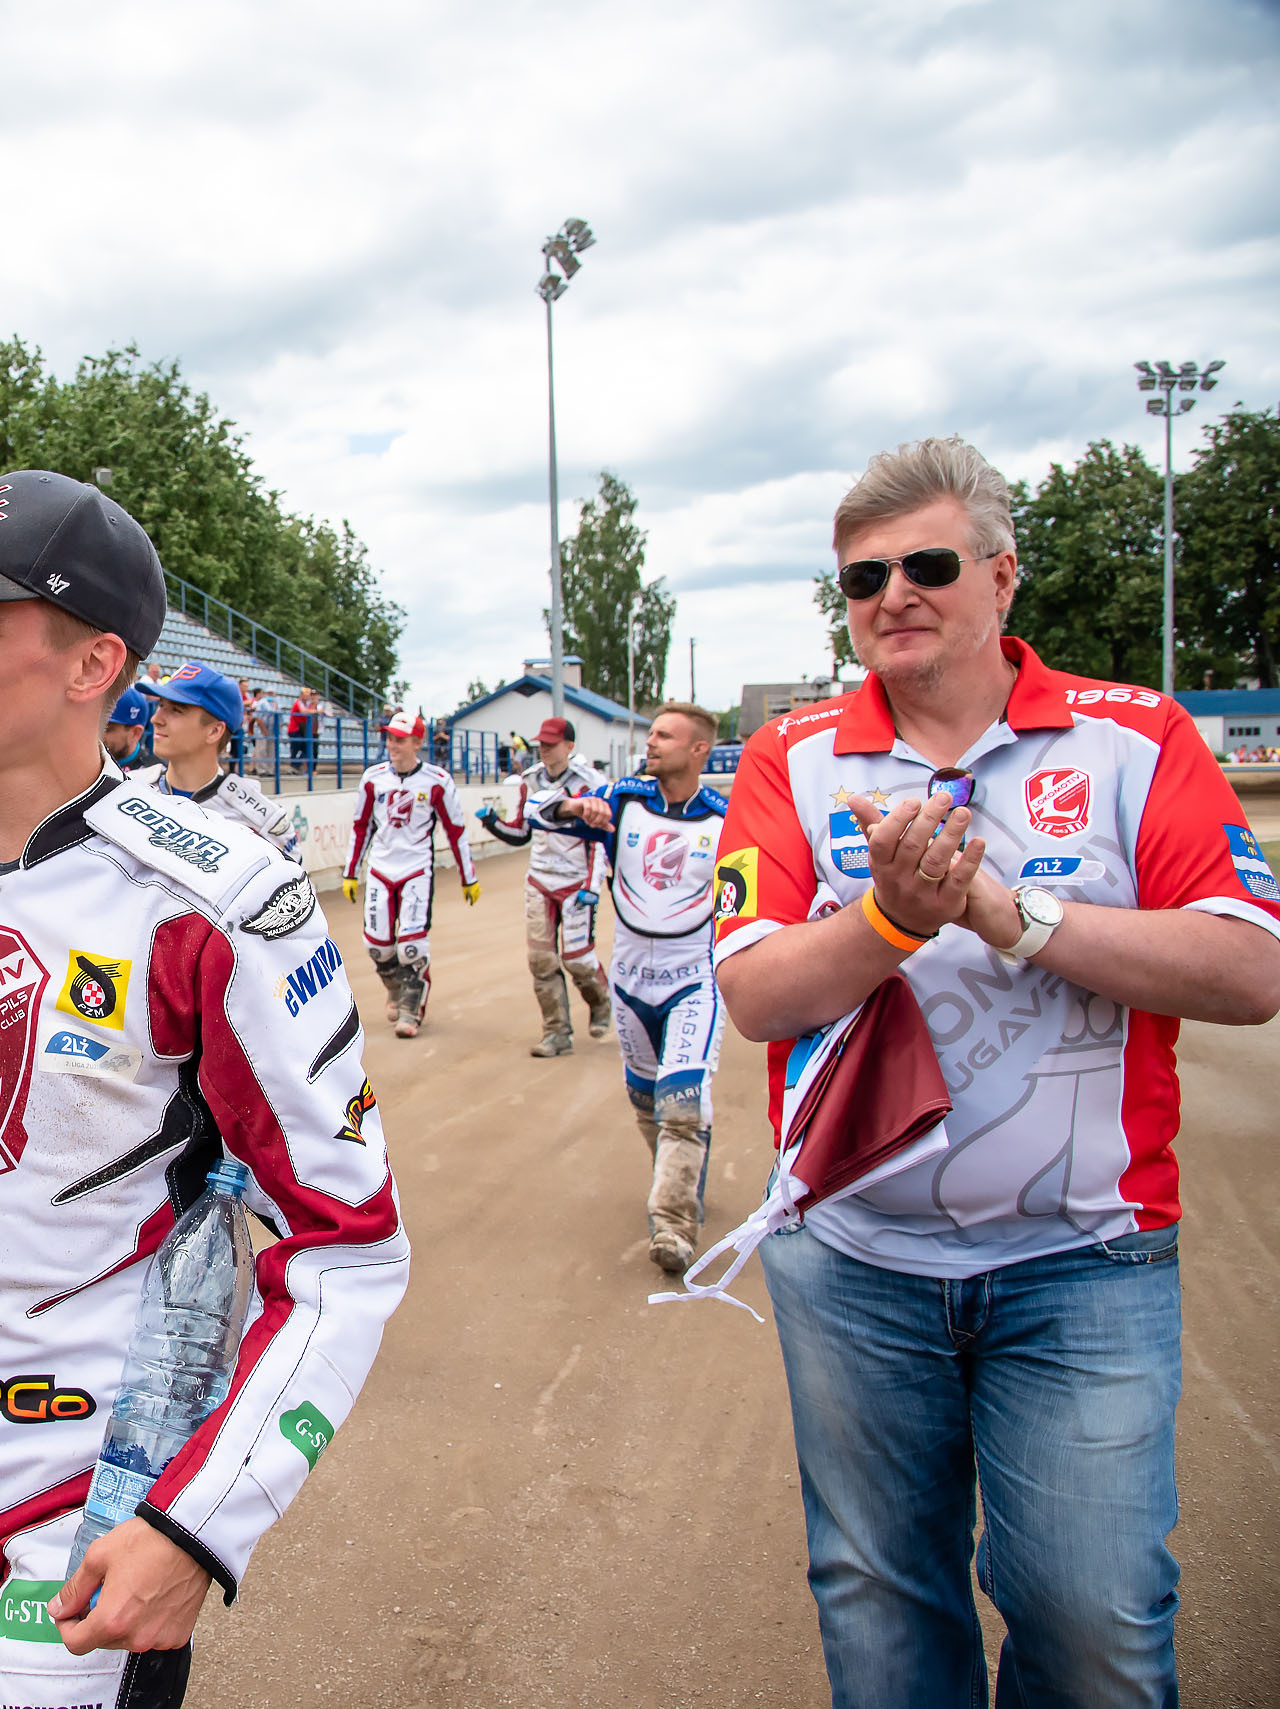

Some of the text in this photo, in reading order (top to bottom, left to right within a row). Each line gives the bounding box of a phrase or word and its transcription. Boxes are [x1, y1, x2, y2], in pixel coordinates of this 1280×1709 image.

[1064, 687, 1162, 708] 1963
[226, 781, 268, 817] SOFIA
[1032, 773, 1081, 809] LOKOMOTIV
[117, 797, 230, 864] GORINA
[1033, 858, 1062, 874] 2LŻ
[616, 961, 700, 981] SAGARI
[0, 1009, 26, 1031] CLUB
[77, 1003, 105, 1017] PZM
